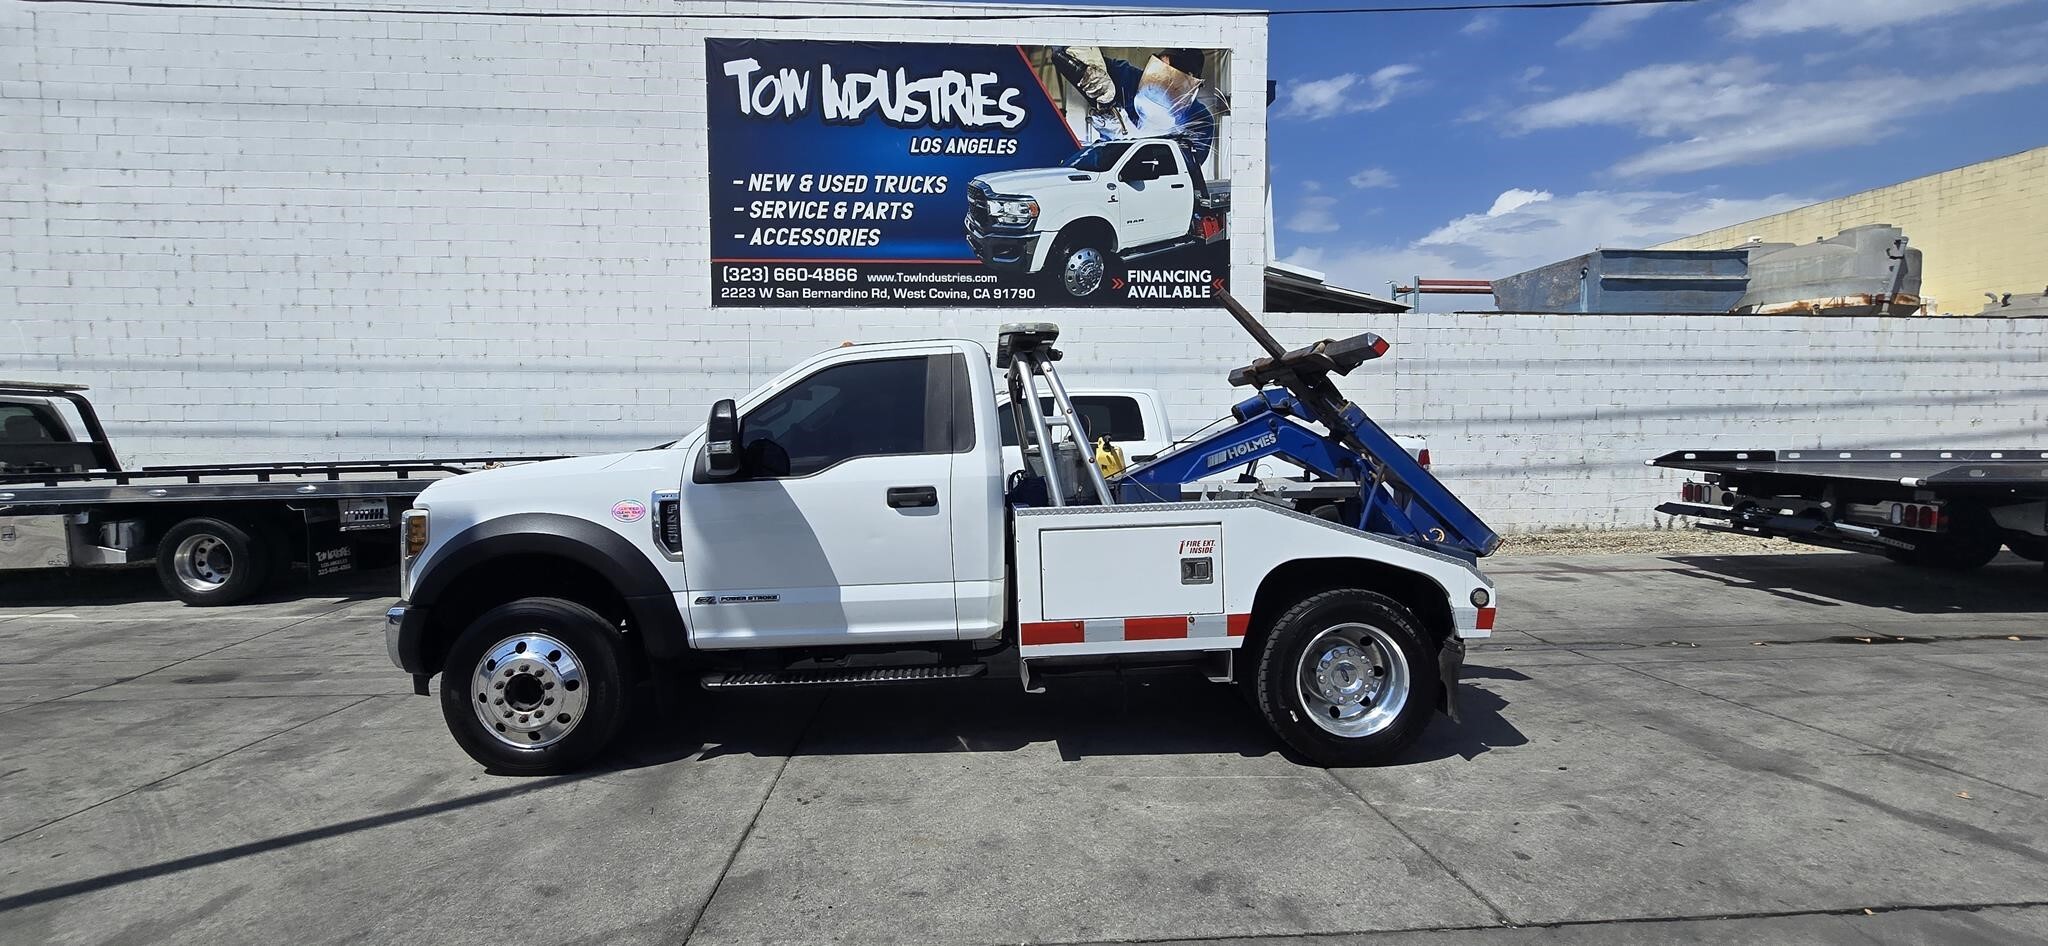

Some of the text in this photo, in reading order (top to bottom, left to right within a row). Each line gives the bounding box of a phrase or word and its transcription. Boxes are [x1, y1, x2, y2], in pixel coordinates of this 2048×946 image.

[910, 137, 1018, 155] LOS ANGELES
[748, 173, 795, 192] NEW
[799, 174, 814, 193] &
[818, 174, 868, 193] USED
[874, 175, 948, 194] TRUCKS
[749, 200, 830, 219] SERVICE
[833, 201, 848, 220] &
[851, 201, 914, 220] PARTS
[749, 227, 881, 247] ACCESSORIES
[723, 265, 858, 283] (323) 660-4866
[866, 272, 998, 283] www.TowIndustries.com
[1127, 269, 1212, 283] FINANCING
[721, 287, 1036, 301] 2223 W San Bernardino Rd, West Covina, CA 91790
[1127, 285, 1211, 299] AVAILABLE
[1227, 434, 1277, 459] HOLMES
[1202, 539, 1216, 547] EXT.
